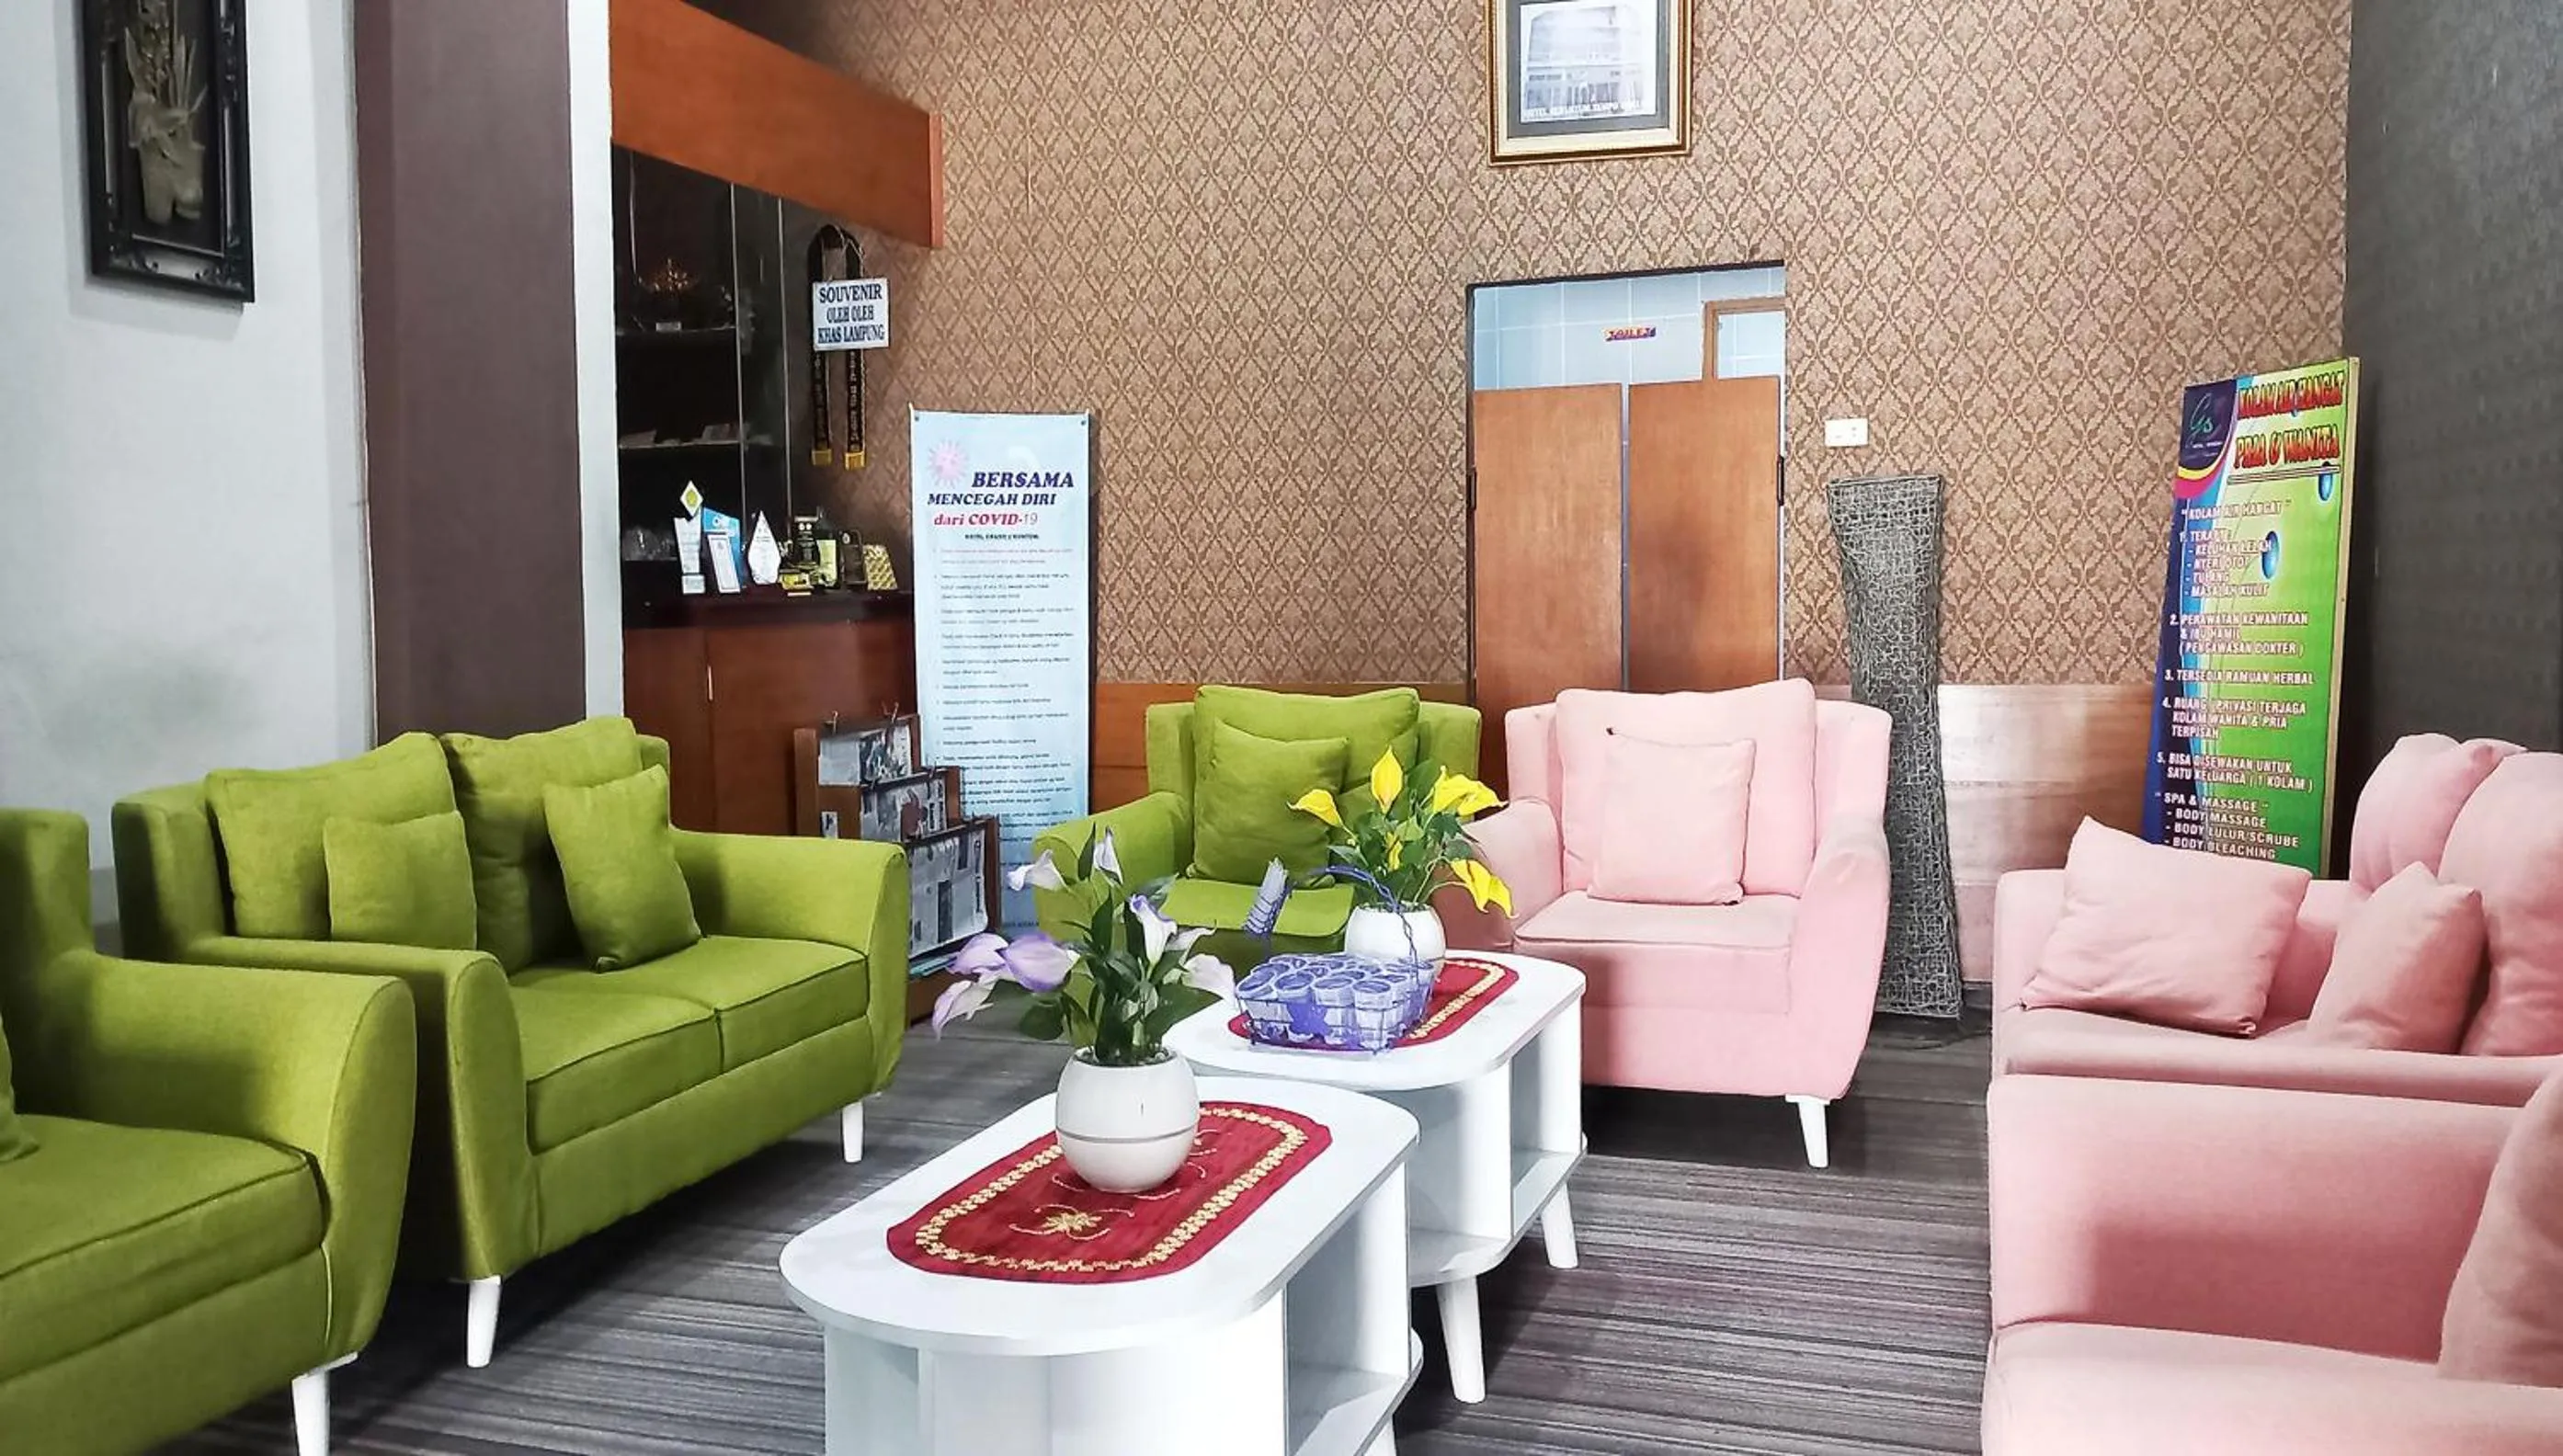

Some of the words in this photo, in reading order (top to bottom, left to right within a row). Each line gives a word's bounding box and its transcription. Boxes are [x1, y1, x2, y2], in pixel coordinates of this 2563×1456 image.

[819, 284, 883, 303] SOUVENIR
[827, 306, 849, 323] OLEH
[851, 305, 874, 322] OLEH
[818, 327, 842, 344] KHAS
[843, 324, 885, 343] LAMPUNG
[2234, 433, 2267, 469] PRIA
[2283, 424, 2341, 463] WANITA
[972, 472, 1074, 488] BERSAMA
[928, 494, 1018, 506] MENCEGAH
[1021, 494, 1056, 506] DIRI
[934, 514, 964, 526] dari
[968, 513, 1039, 526] COVID-19
[2189, 506, 2220, 519] KOLAM
[2181, 613, 2239, 626] PERAWATAN
[2242, 612, 2308, 625] KEWANITAAN
[2165, 669, 2174, 681] 3.
[2273, 671, 2315, 685] HERBAL
[2162, 697, 2171, 708] 4.
[2259, 701, 2307, 715] TERJAGA
[2172, 711, 2206, 724] KOLAM
[2208, 713, 2250, 726] WANITA
[2261, 716, 2287, 729] PRIA
[2169, 753, 2192, 766] BISA
[2256, 761, 2293, 774] UNTUK
[2167, 767, 2193, 779] SATU
[2194, 769, 2246, 785] KELUARGA
[2267, 775, 2306, 790] KOLAM
[2164, 792, 2185, 805] SPA
[2188, 794, 2197, 805] &
[2202, 797, 2259, 813] MASSAGE
[2175, 808, 2205, 821] BODY
[2209, 813, 2267, 828] MASSAGE
[2174, 822, 2204, 836] BODY
[2173, 837, 2204, 850] BODY
[2207, 842, 2276, 859] BLEACHING
